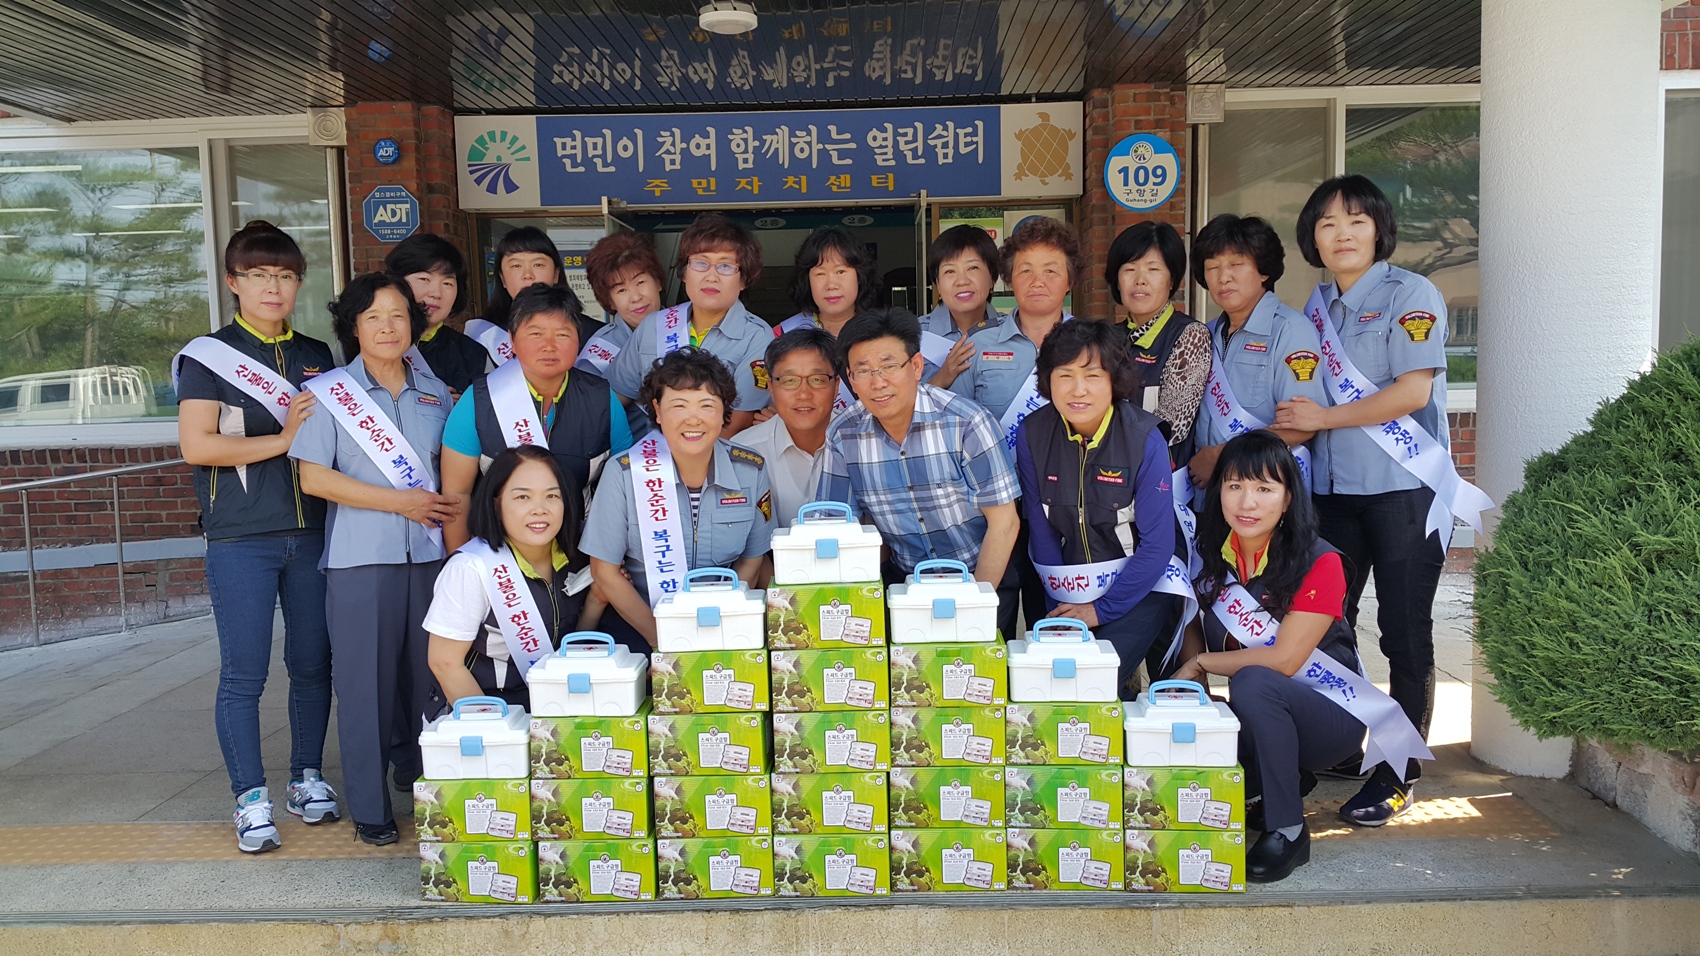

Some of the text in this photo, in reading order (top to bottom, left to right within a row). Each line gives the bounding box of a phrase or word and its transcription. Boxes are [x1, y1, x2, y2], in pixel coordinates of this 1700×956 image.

[378, 147, 395, 157] ADT
[553, 120, 984, 172] 면민이 참여 함께하는 열린쉼터
[644, 174, 894, 196] 주민자치센터
[1117, 164, 1168, 187] 109
[1122, 188, 1158, 198] 구항길
[373, 203, 410, 223] ADT
[328, 381, 364, 417] 산불은
[357, 415, 396, 453] 한순간
[639, 439, 662, 472] 산불은
[644, 477, 669, 522] 한순간
[652, 529, 676, 574] 복구는
[1048, 573, 1090, 593] 한순간
[492, 563, 541, 653] 산불은 한순간
[1226, 598, 1267, 637] 한순간
